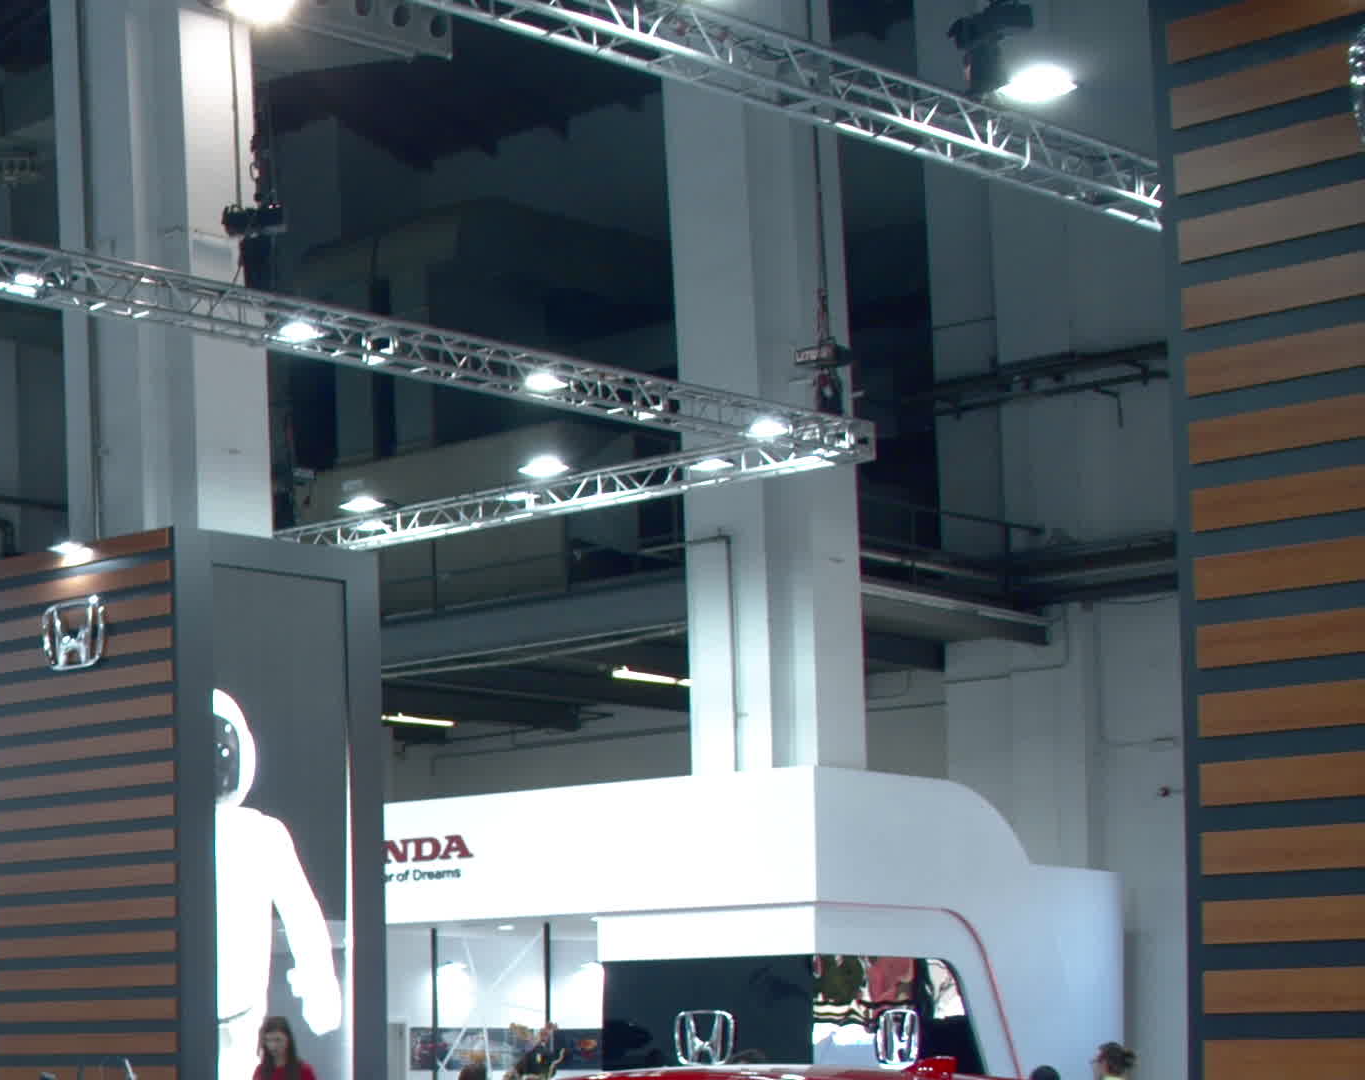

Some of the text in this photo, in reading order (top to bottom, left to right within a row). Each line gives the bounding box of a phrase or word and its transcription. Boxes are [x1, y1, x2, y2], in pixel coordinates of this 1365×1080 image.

[382, 834, 474, 863] NDA
[396, 869, 409, 882] of
[412, 868, 462, 881] Dreams
